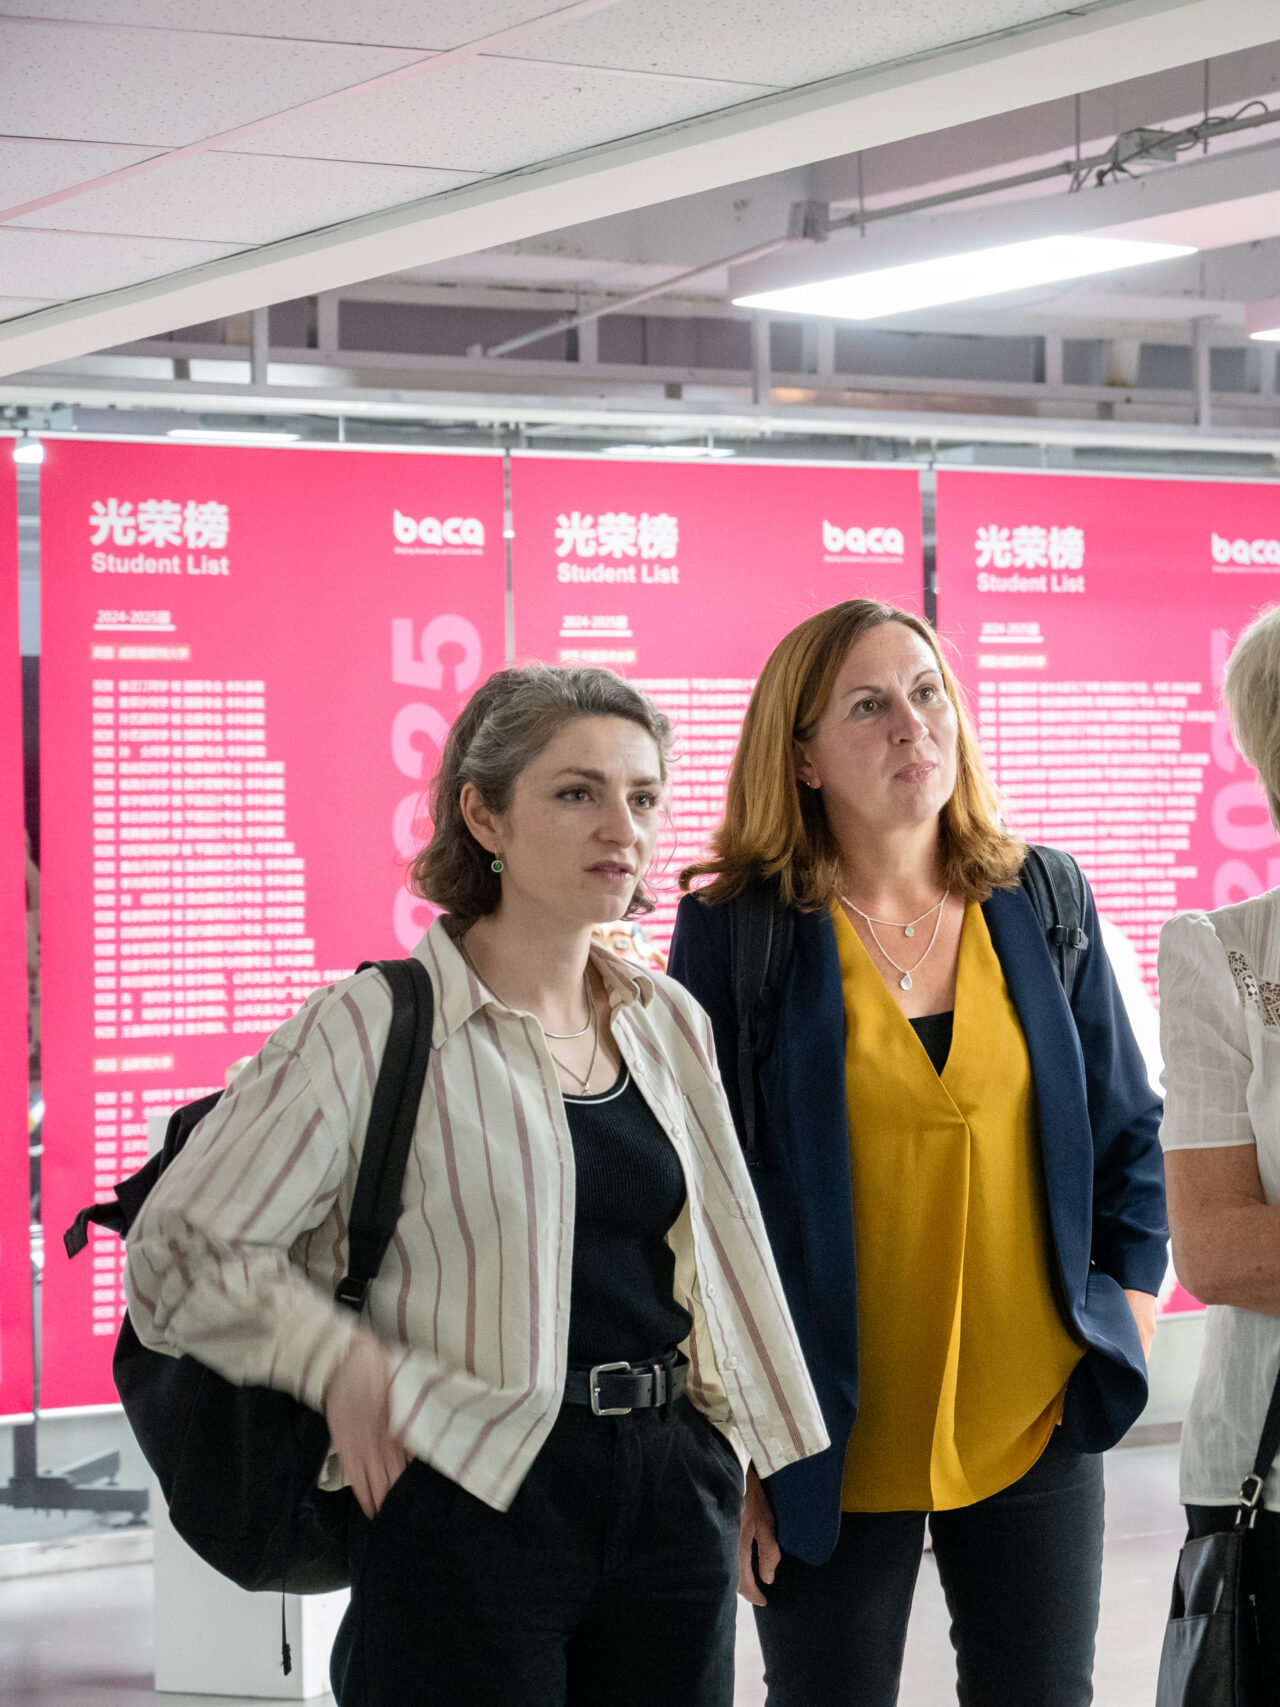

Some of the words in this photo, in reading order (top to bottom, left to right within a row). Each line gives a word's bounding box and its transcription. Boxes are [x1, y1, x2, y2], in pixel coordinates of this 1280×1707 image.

[89, 498, 230, 549] 光荣榜
[393, 509, 485, 547] baca
[554, 511, 679, 560] 光荣榜
[822, 520, 905, 555] baca
[91, 551, 181, 575] Student
[186, 554, 230, 576] List
[974, 525, 1085, 569] 光荣榜
[557, 562, 637, 584] Student
[640, 563, 679, 585] List
[976, 572, 1048, 593] Student
[1050, 574, 1085, 593] List
